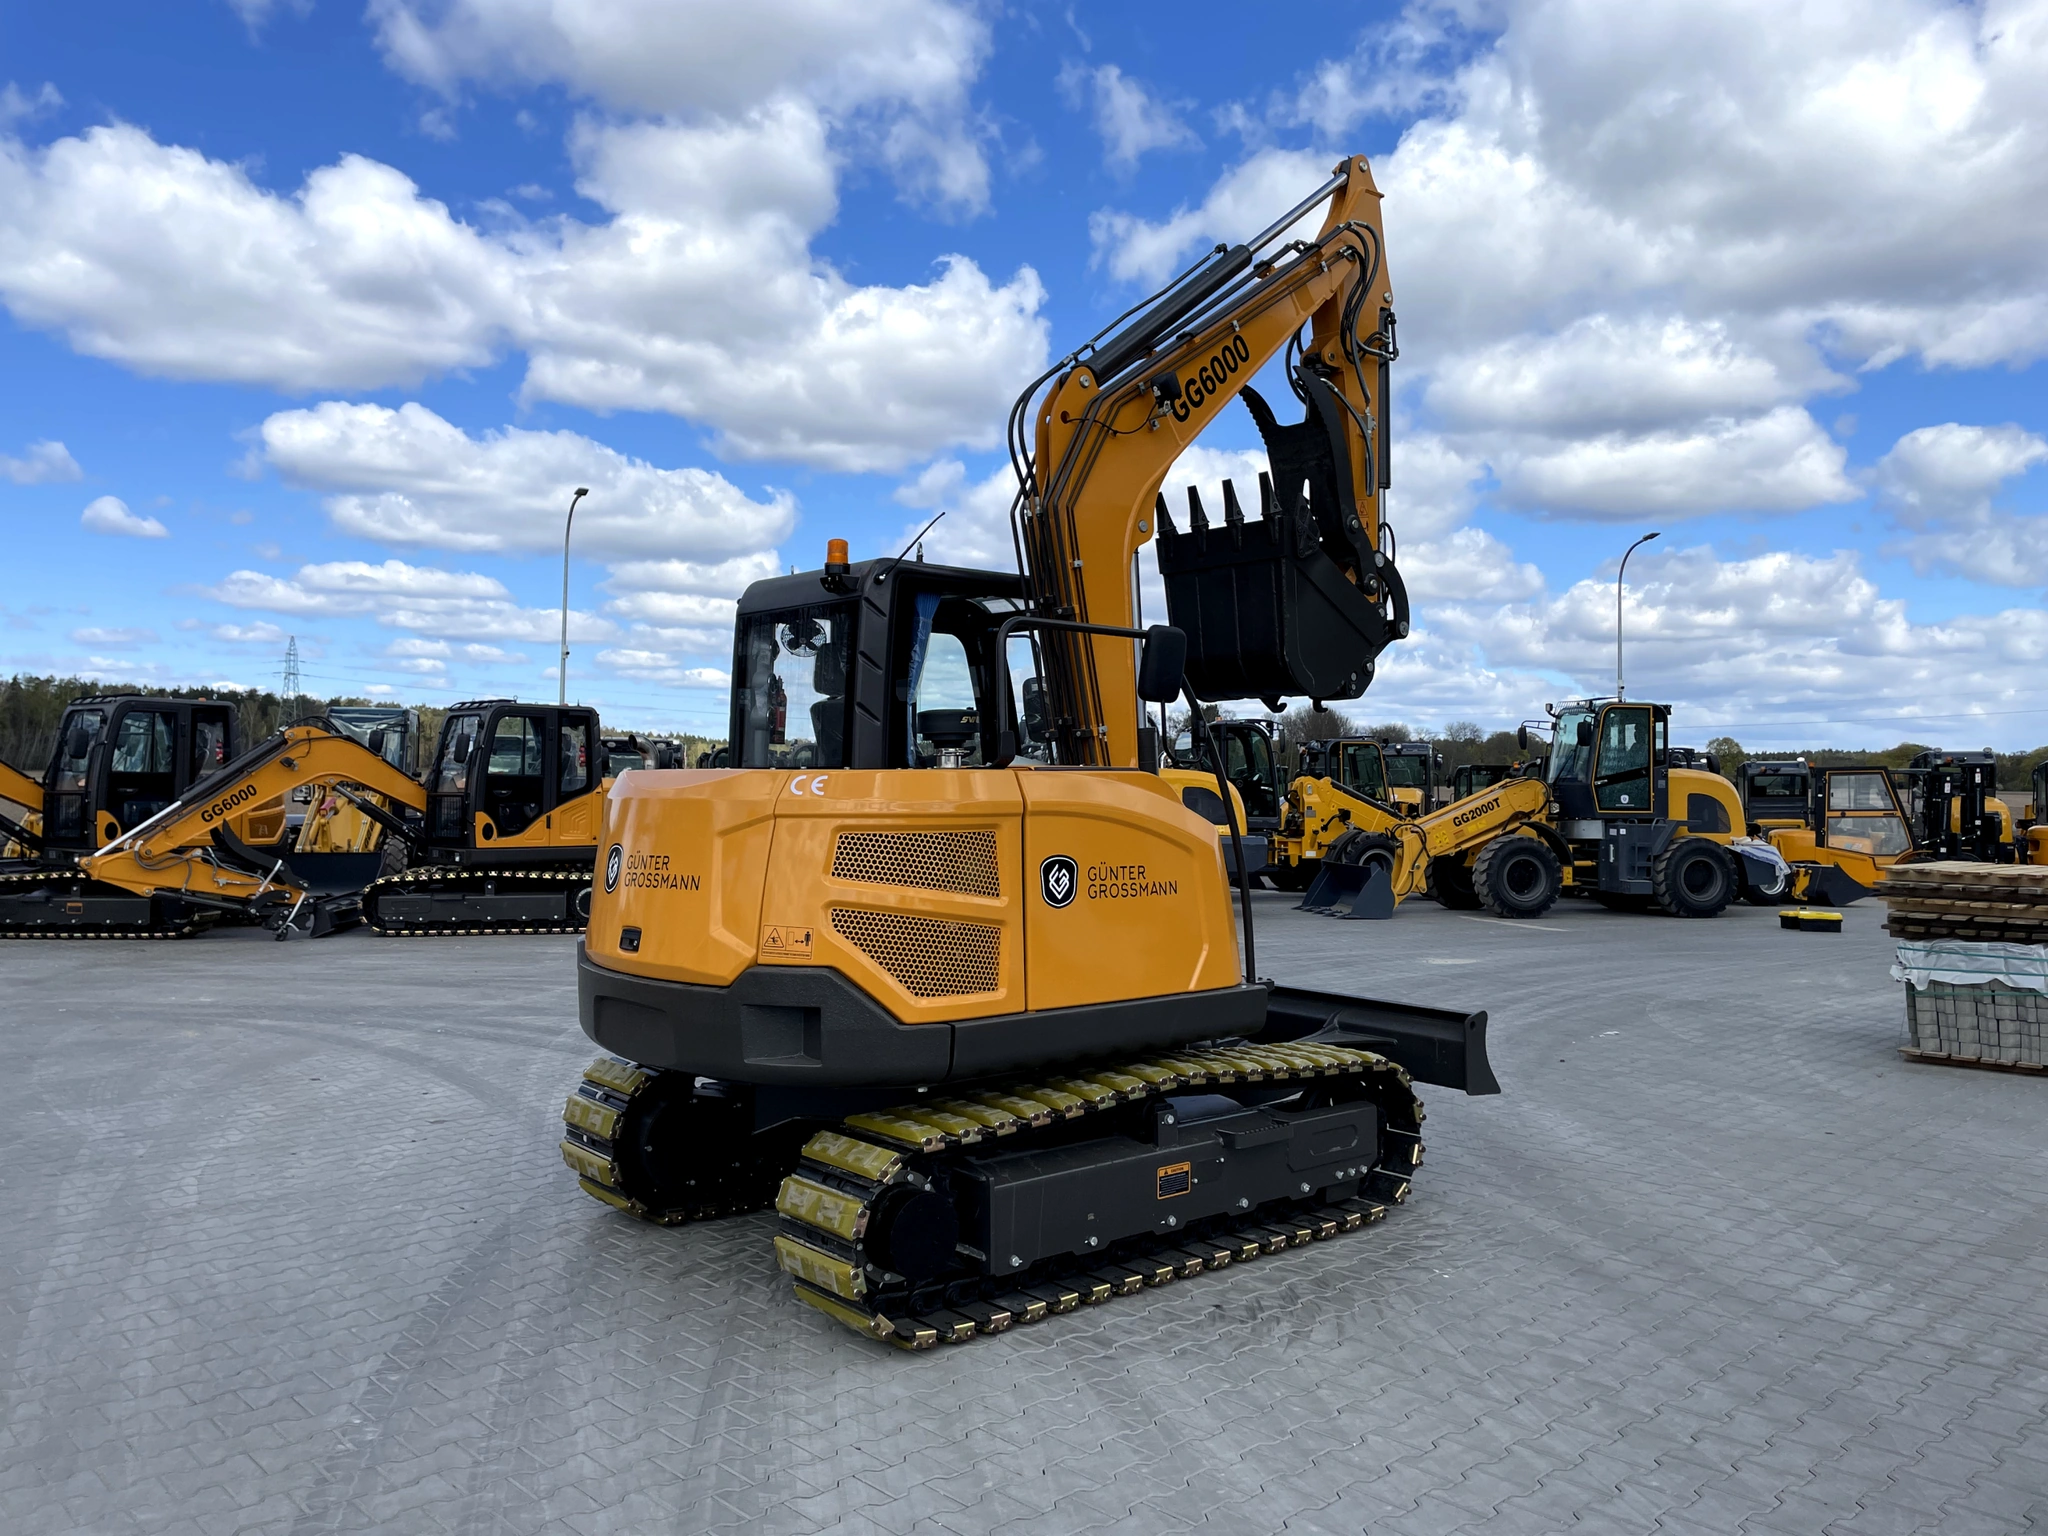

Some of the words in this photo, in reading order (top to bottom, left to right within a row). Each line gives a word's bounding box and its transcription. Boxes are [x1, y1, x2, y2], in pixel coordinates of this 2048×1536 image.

[1170, 334, 1250, 423] GG6000
[790, 774, 829, 796] CE
[200, 784, 258, 823] GG6000
[1452, 797, 1501, 827] GG2000T
[626, 850, 670, 871] GÜNTER
[624, 871, 701, 891] GROSSMANN
[1087, 861, 1147, 882] GÜNTER
[1087, 880, 1178, 900] GROSSMANN
